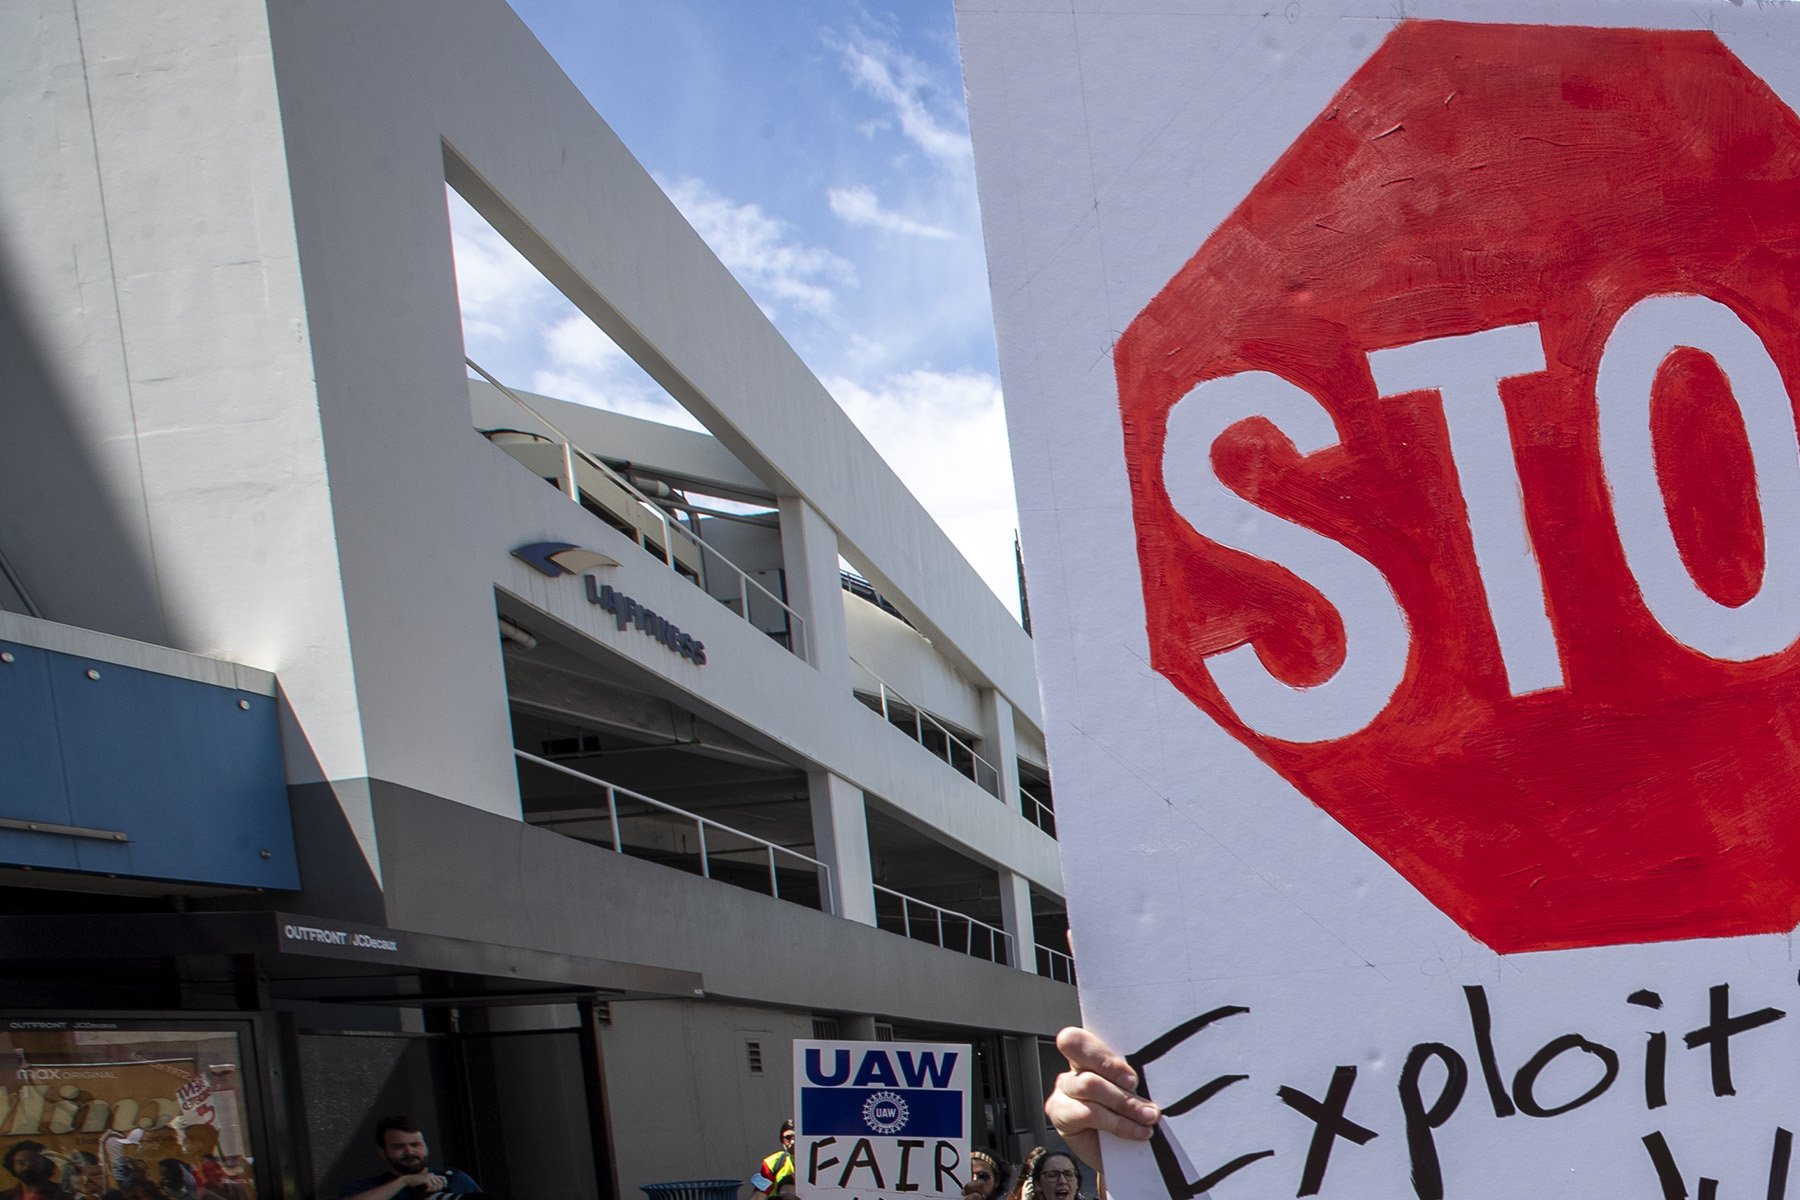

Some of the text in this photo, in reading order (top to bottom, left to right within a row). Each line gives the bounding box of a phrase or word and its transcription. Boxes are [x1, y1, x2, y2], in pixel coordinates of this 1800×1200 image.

[284, 924, 398, 952] OUTFRONT JCDecaux
[16, 1068, 117, 1082] max ORIGINAL
[805, 1048, 959, 1088] UAW
[875, 1108, 897, 1118] UAW
[807, 1136, 965, 1193] FAIR
